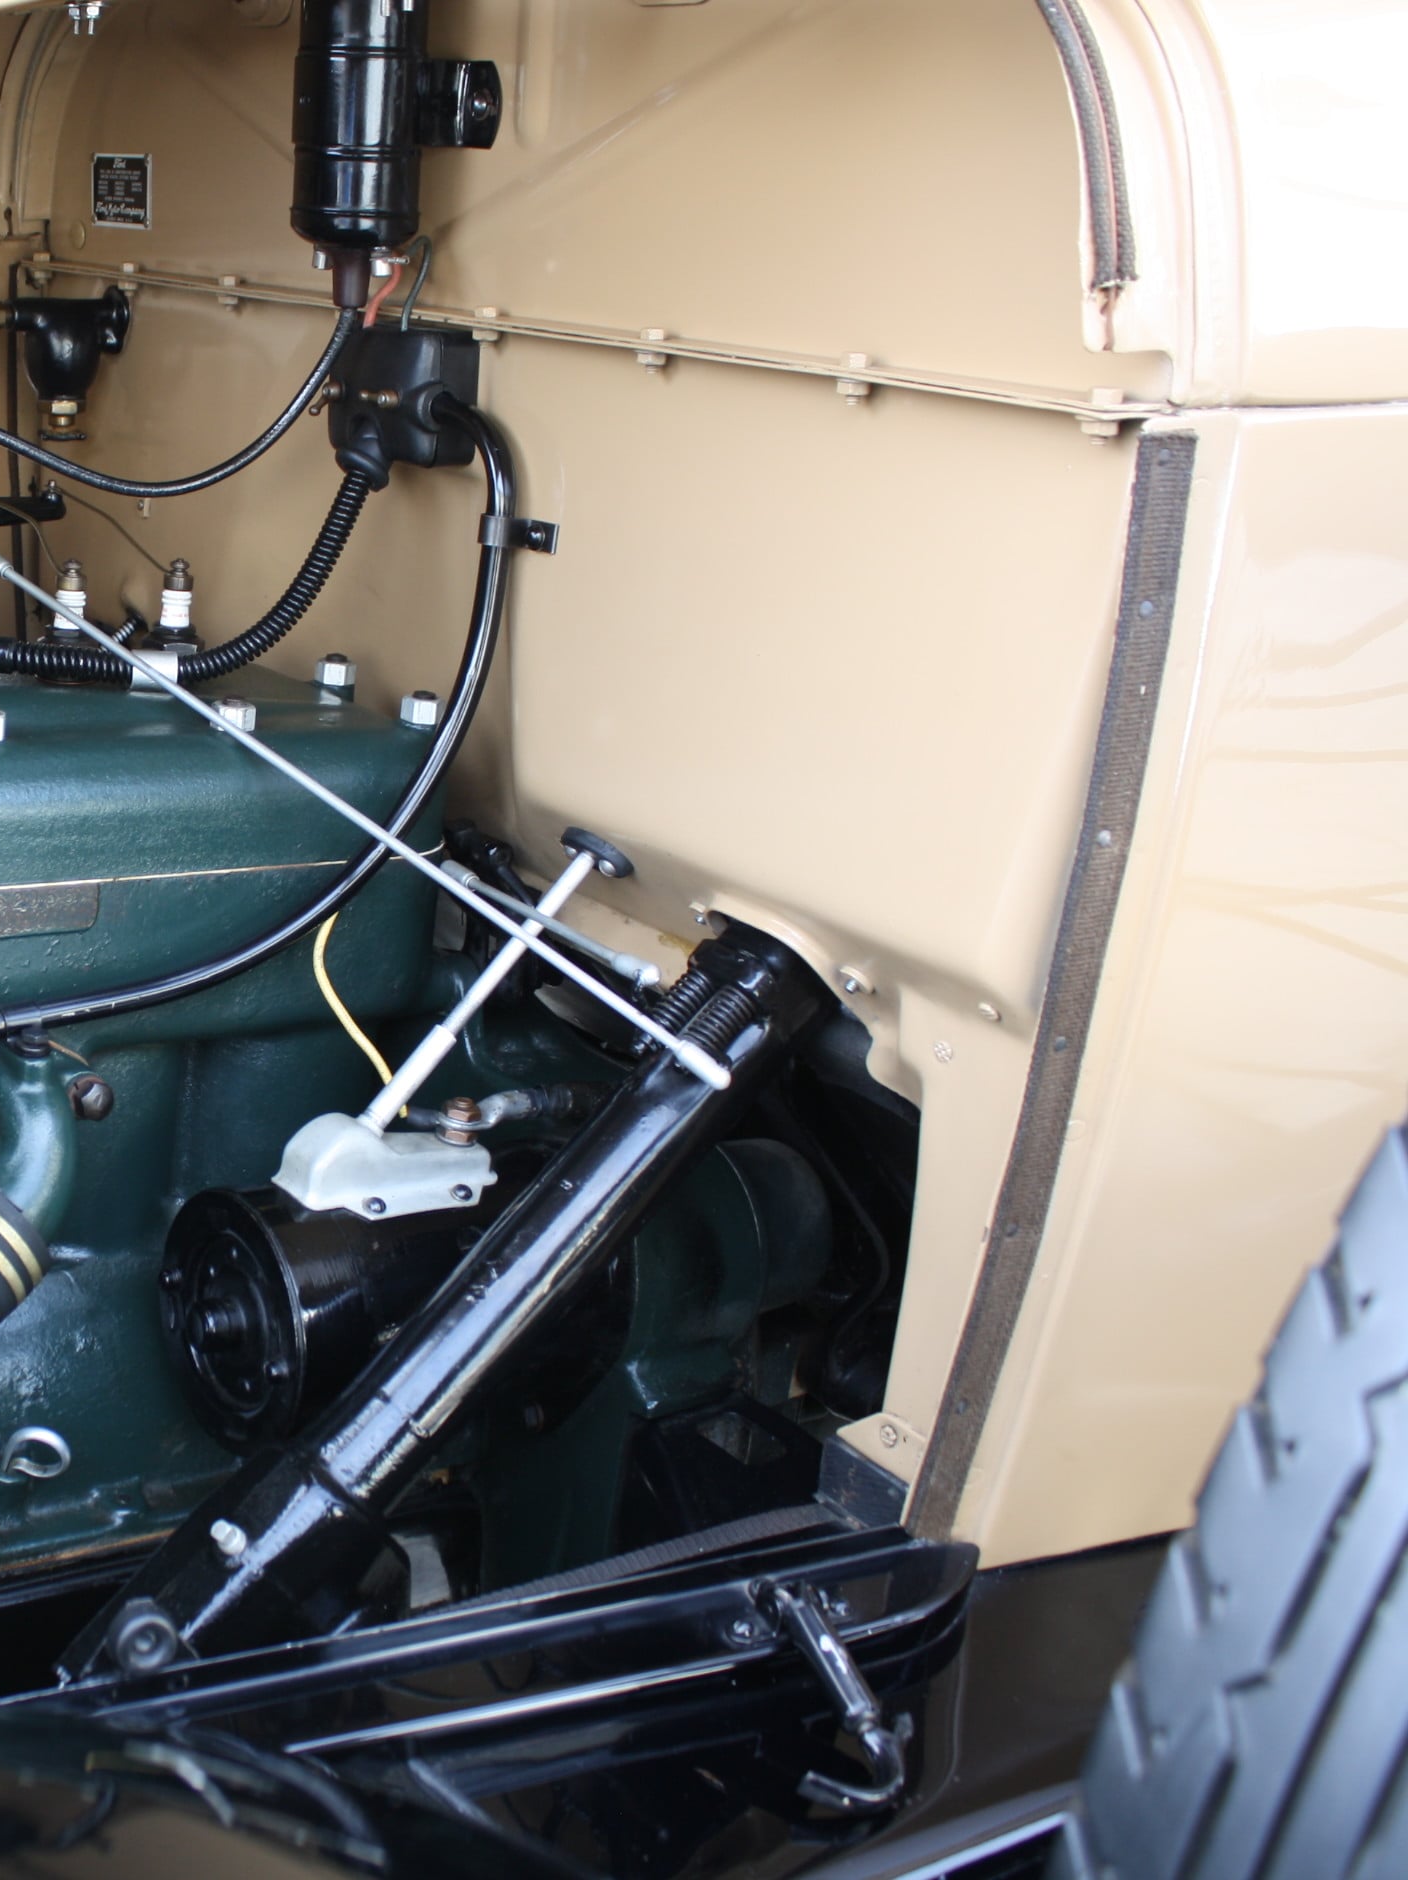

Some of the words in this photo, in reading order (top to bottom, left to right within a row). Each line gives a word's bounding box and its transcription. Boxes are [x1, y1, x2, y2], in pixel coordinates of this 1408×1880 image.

[113, 158, 126, 168] Ford
[96, 201, 108, 214] Ford
[120, 202, 145, 220] Company
